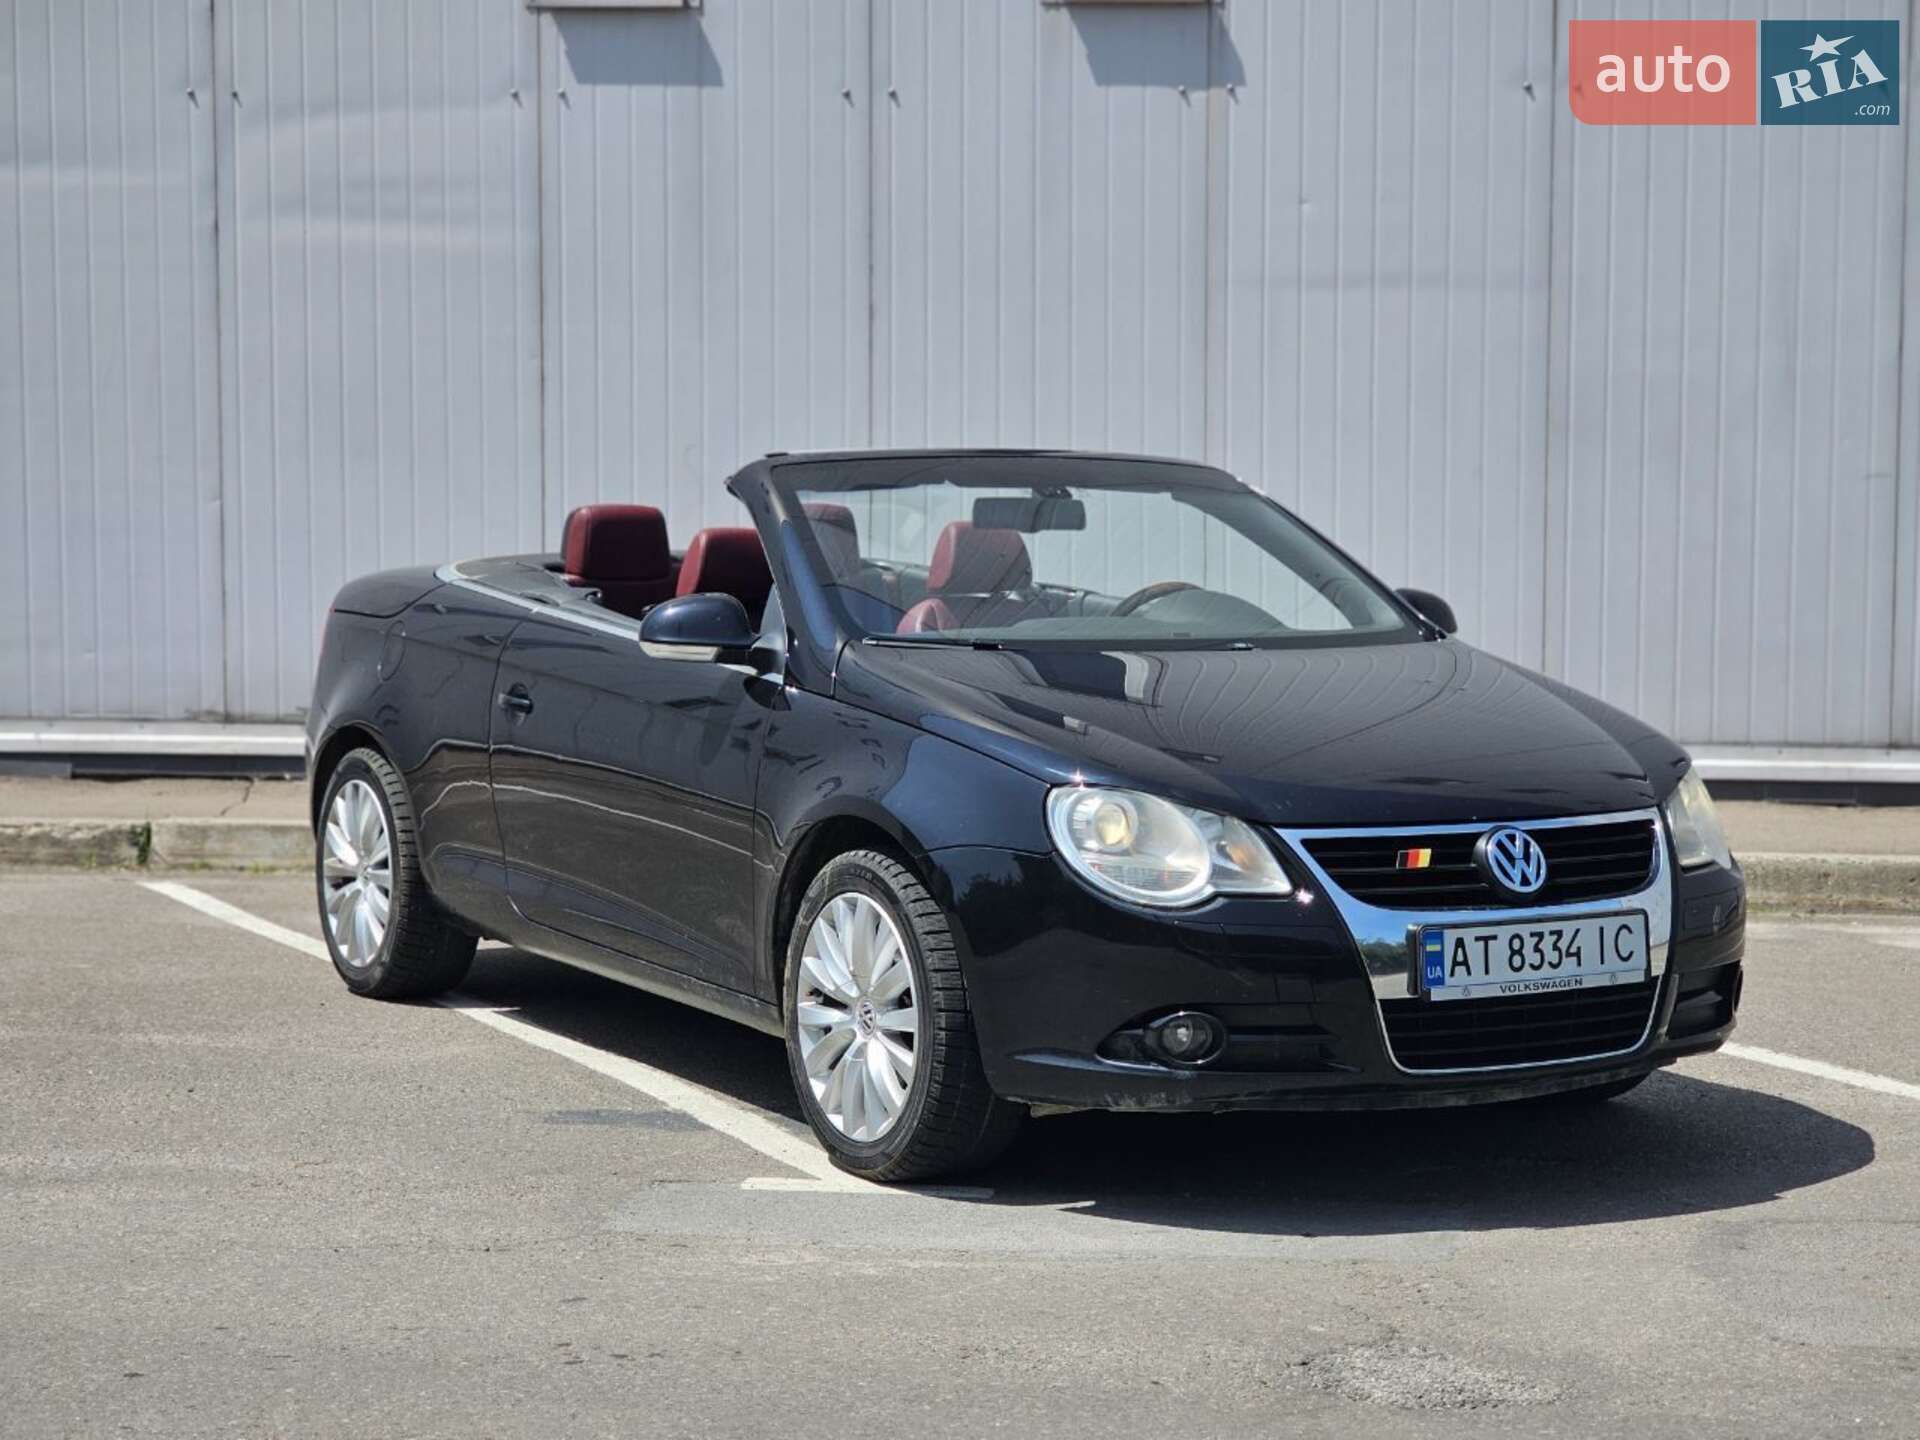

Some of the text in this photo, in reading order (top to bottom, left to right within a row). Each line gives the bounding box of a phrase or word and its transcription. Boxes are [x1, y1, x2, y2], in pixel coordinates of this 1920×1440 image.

[1449, 923, 1635, 978] AT 8334 IC
[1426, 967, 1442, 979] UA
[1499, 978, 1584, 994] VOLKSWAGEN
